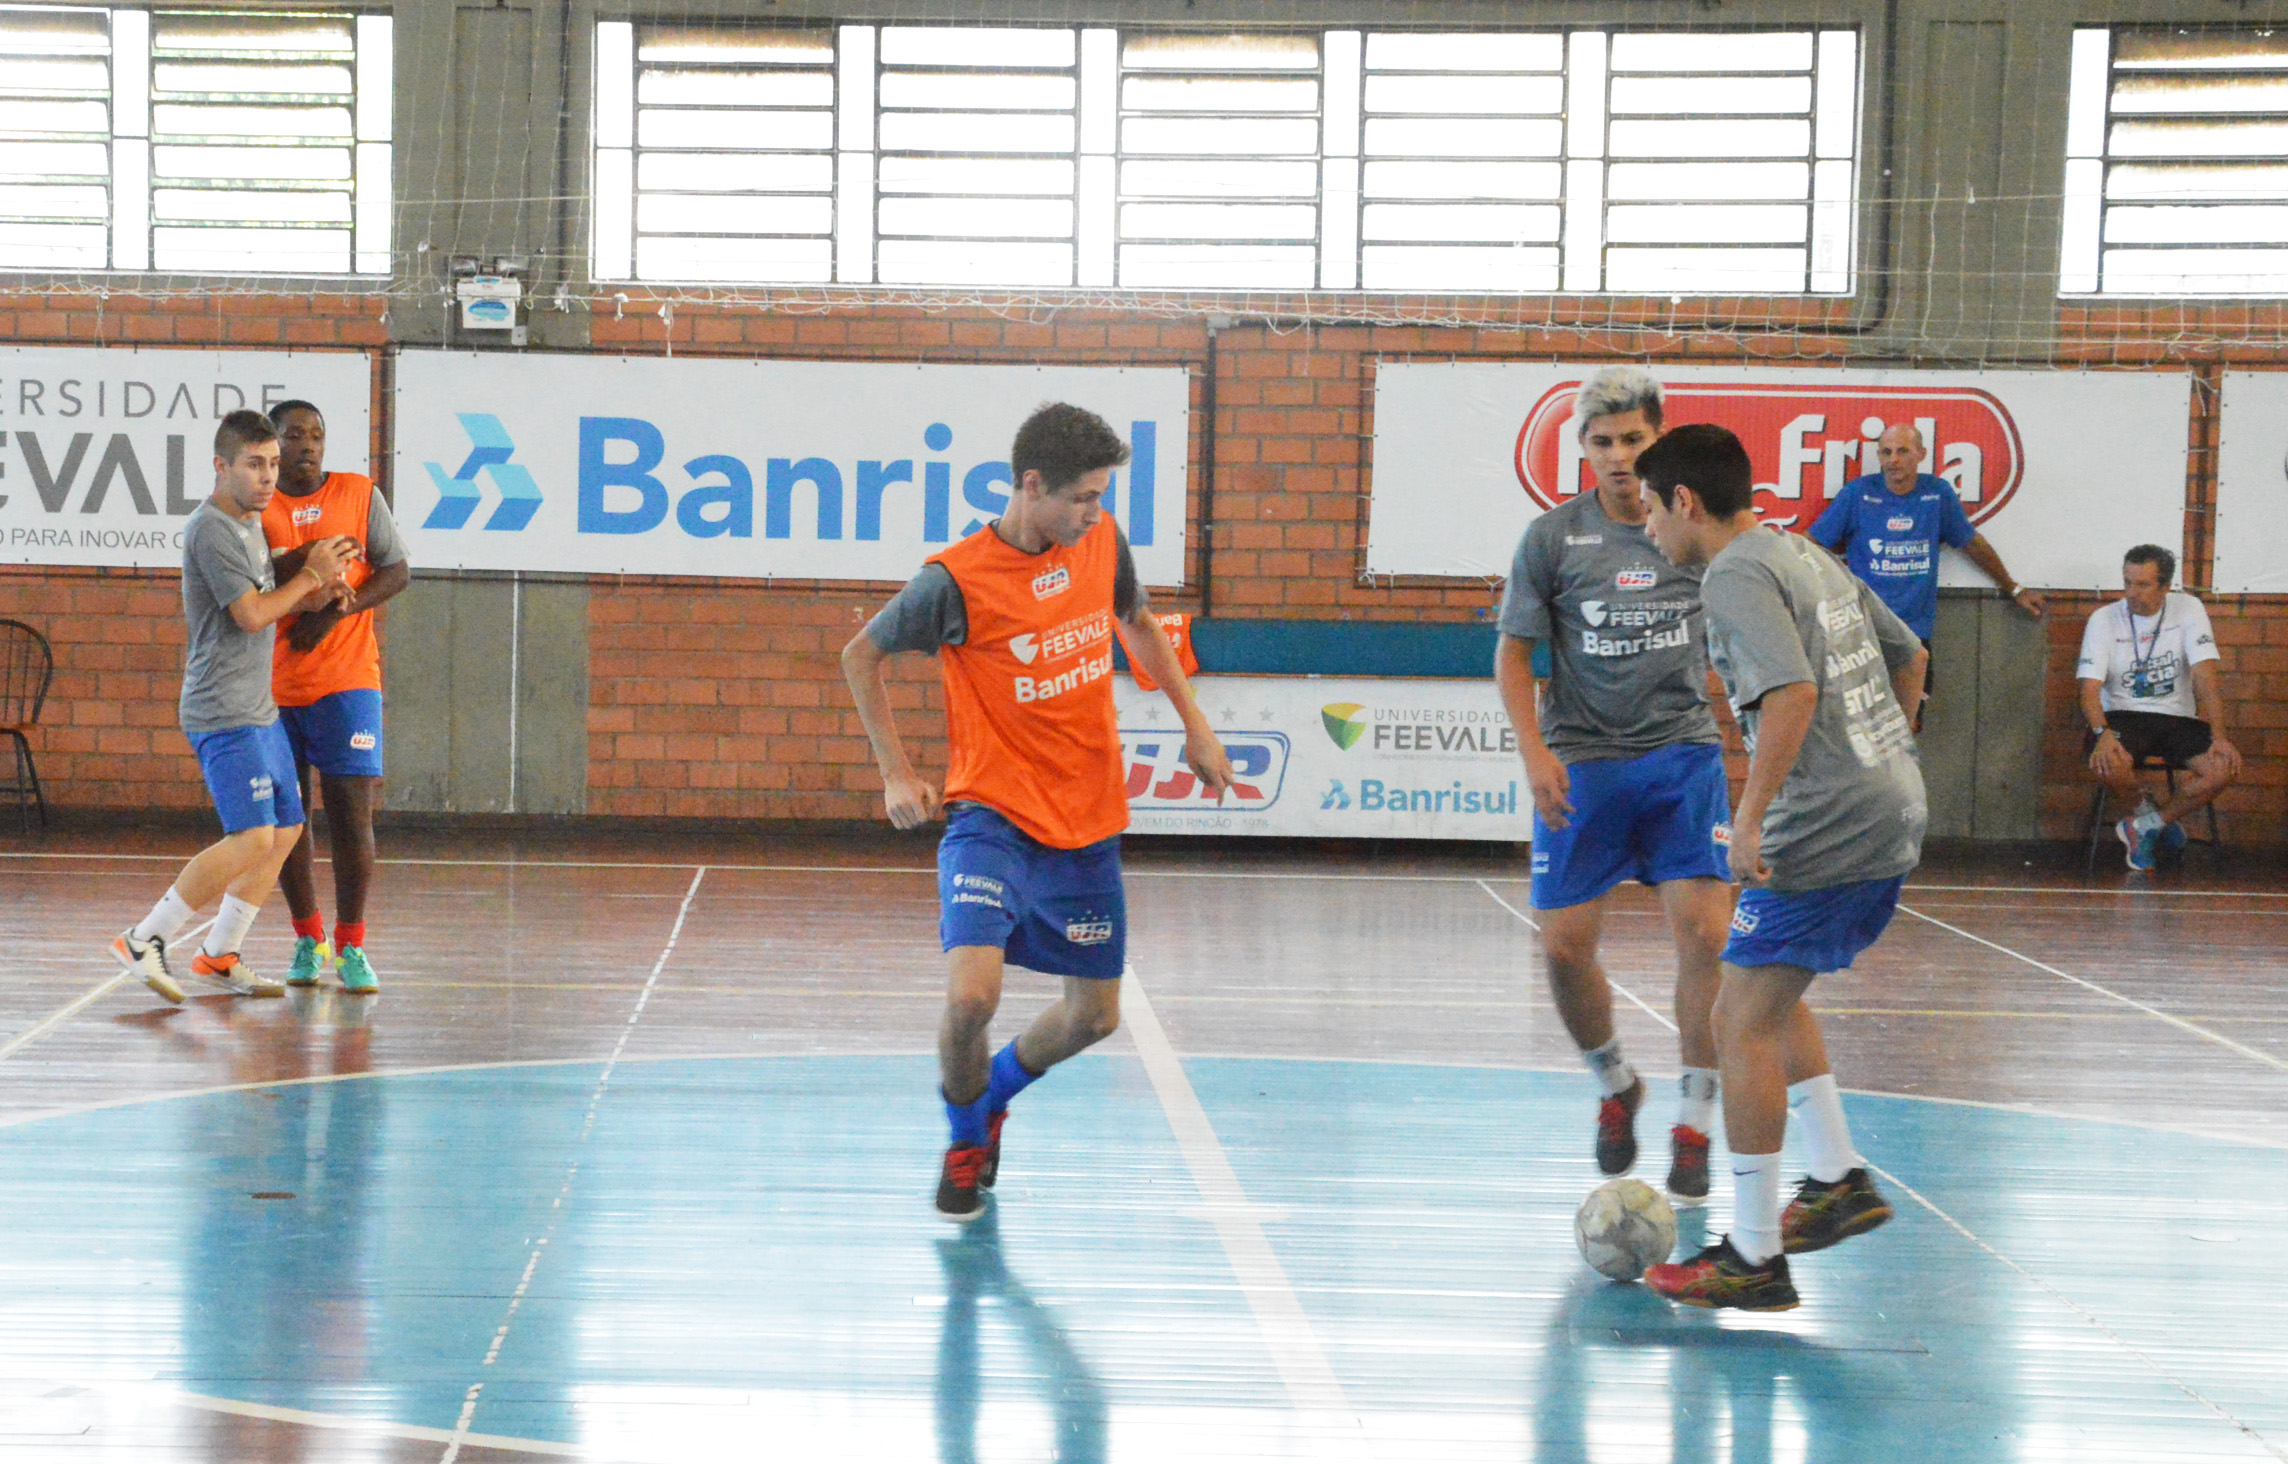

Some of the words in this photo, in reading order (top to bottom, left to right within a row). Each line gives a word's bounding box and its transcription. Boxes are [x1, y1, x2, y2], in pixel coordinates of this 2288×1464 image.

[577, 415, 1157, 547] Banrisl
[11, 528, 72, 548] PARA
[80, 530, 166, 549] INOVAR
[1042, 615, 1110, 658] FEEVALE
[1582, 619, 1691, 657] Banrisul
[1014, 653, 1113, 703] Banrisu
[1374, 708, 1510, 724] UNIVERSIDAD
[1374, 724, 1517, 753] FEEVALE
[1360, 778, 1517, 815] Banrisul
[1129, 817, 1162, 829] OVEM
